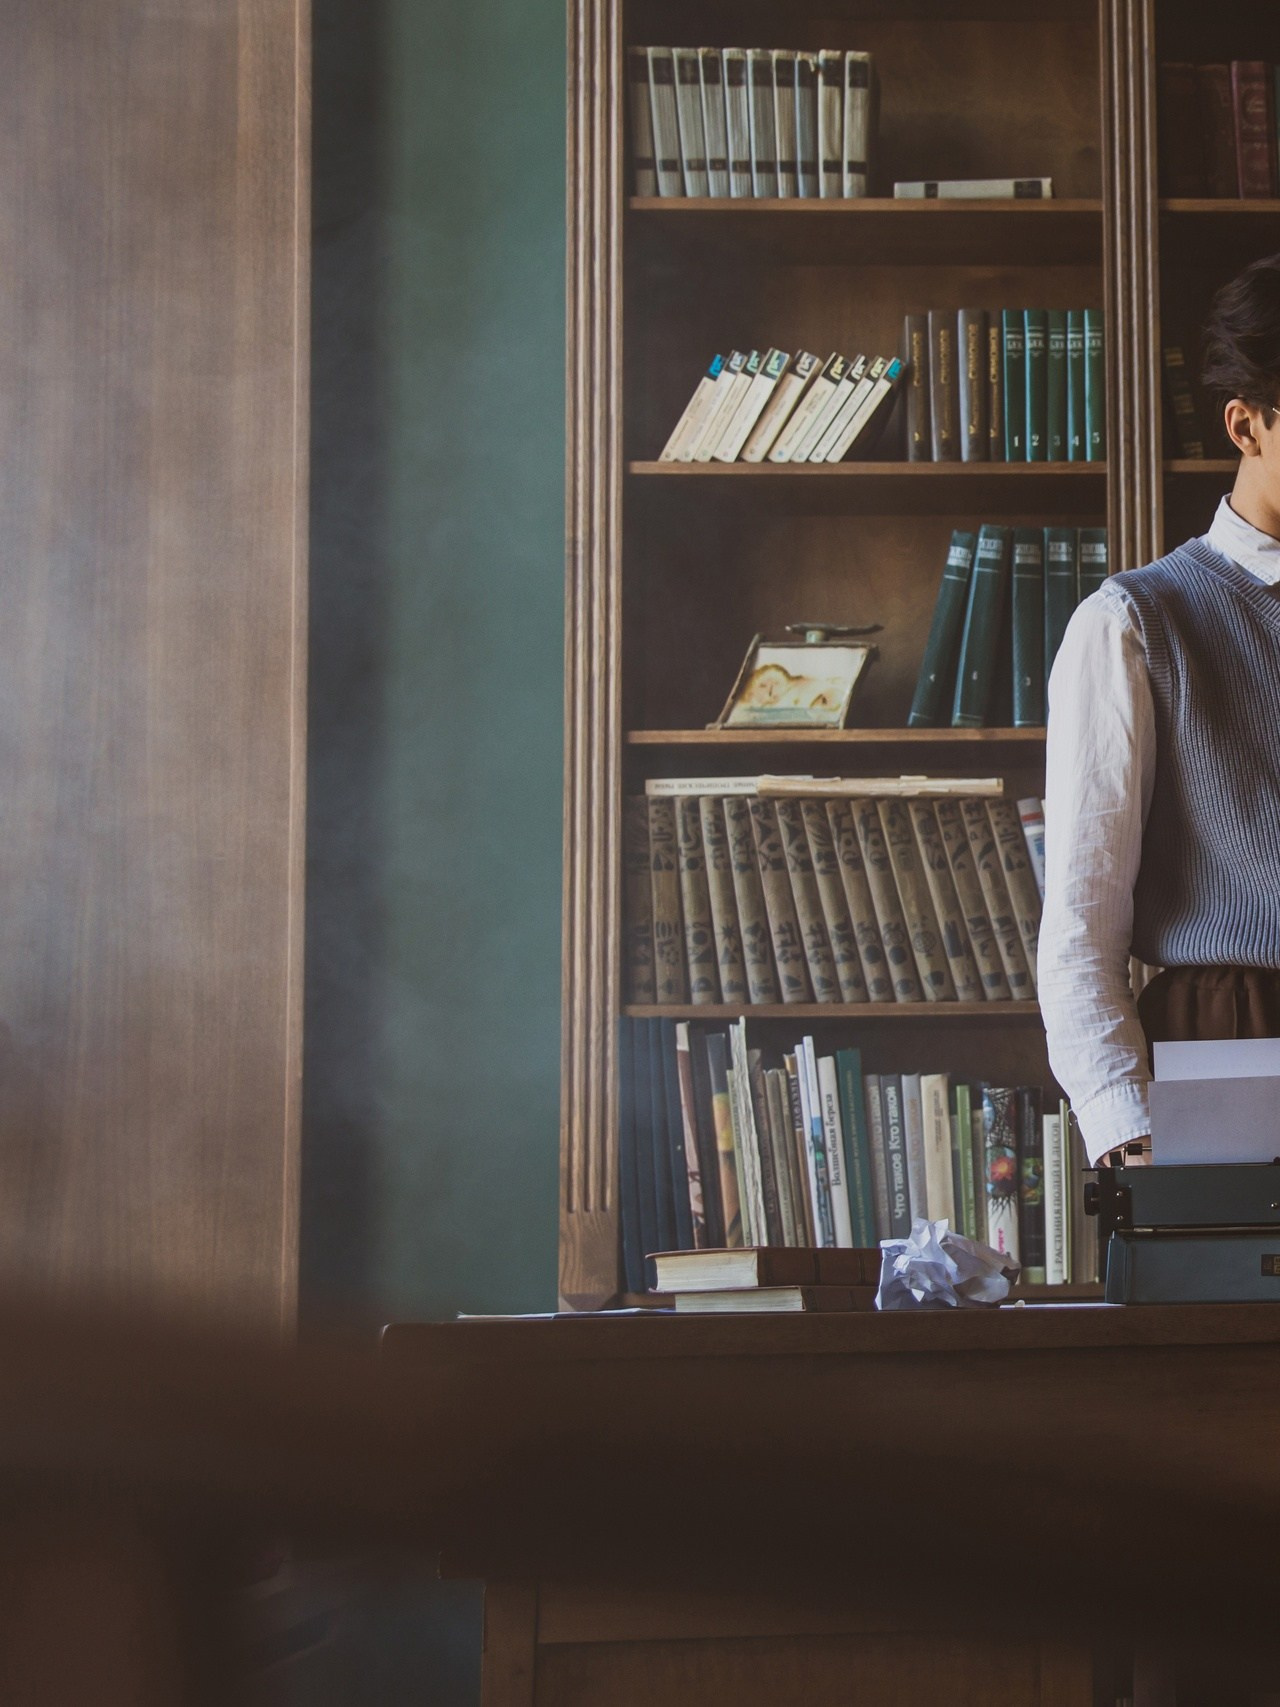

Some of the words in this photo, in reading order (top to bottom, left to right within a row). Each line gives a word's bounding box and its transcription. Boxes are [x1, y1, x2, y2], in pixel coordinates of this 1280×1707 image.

[1013, 435, 1019, 447] 1
[1031, 434, 1039, 447] 2
[1053, 435, 1061, 446] 3
[1071, 435, 1079, 446] 4
[1092, 432, 1100, 444] 5
[793, 1077, 803, 1127] РАФАЭЛЬ
[825, 1094, 835, 1127] береза
[869, 1085, 881, 1122] такой
[886, 1086, 899, 1123] такой
[888, 1124, 900, 1150] Кто
[1052, 1122, 1061, 1158] ЛЕСОВ
[829, 1129, 841, 1187] Волшебная
[890, 1152, 904, 1191] такое
[1053, 1159, 1062, 1167] И
[1053, 1170, 1063, 1207] ПОЛЕЙ
[894, 1193, 906, 1218] Что
[1054, 1208, 1063, 1264] РАСТЕНИЯ
